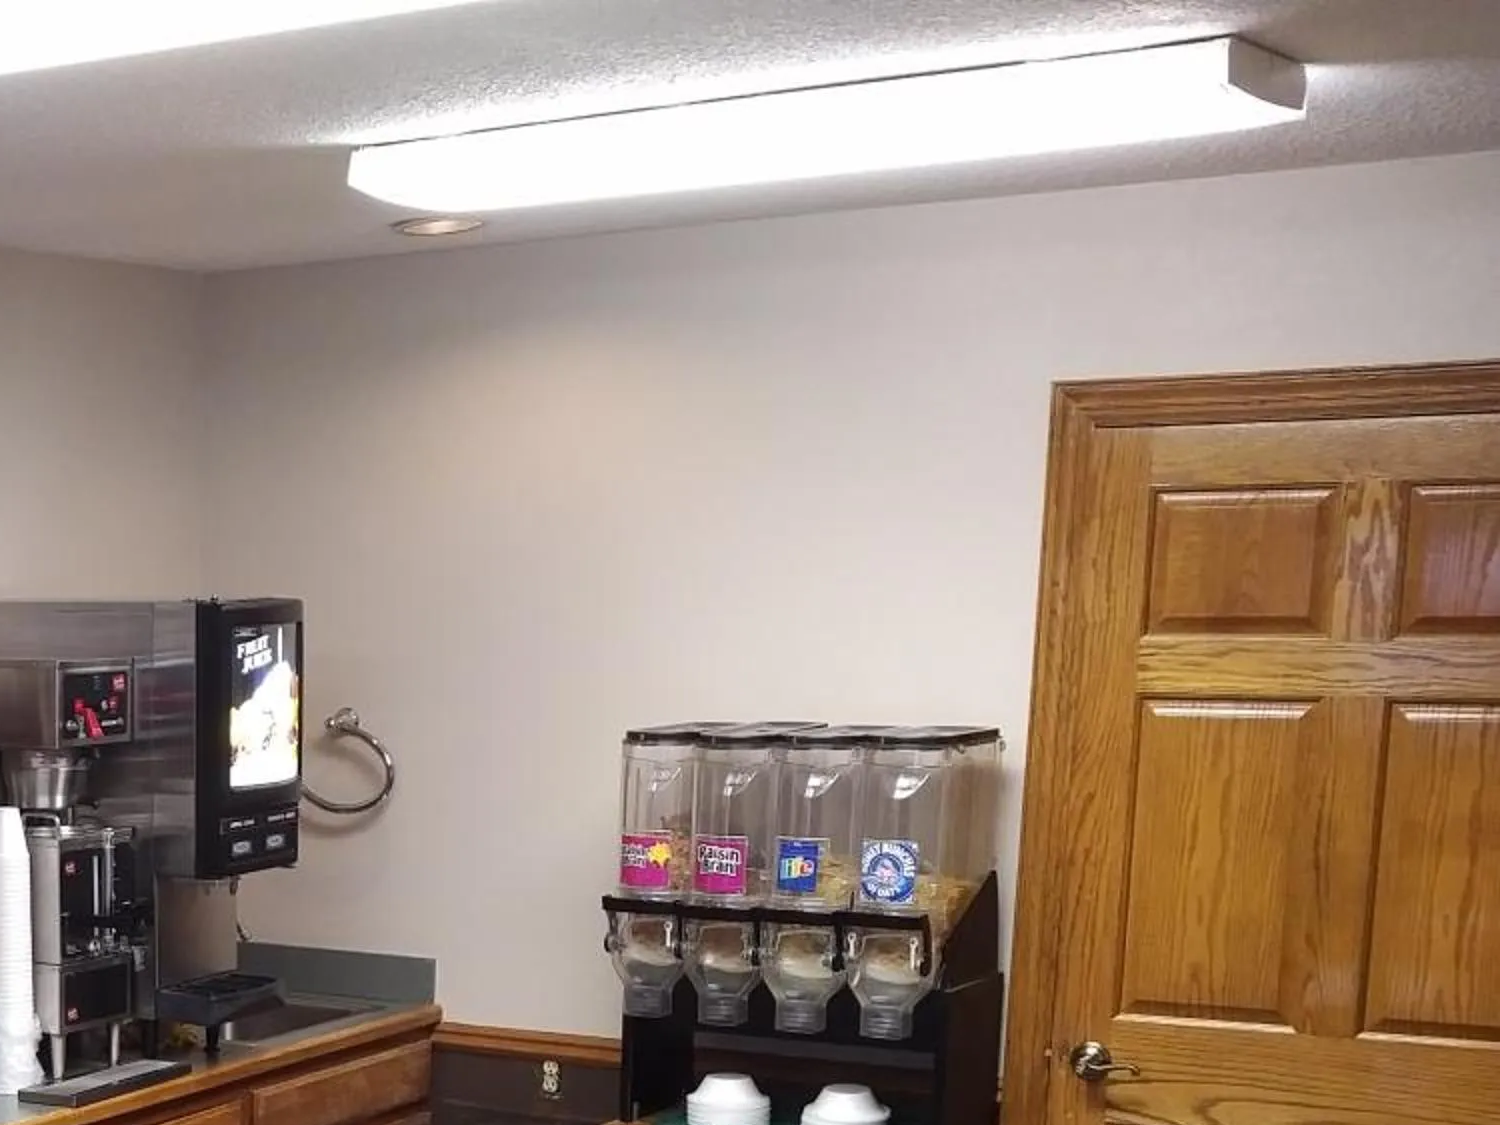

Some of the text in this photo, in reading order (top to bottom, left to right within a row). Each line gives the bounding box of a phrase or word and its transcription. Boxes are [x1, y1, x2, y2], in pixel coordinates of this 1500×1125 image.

[236, 634, 269, 659] FRUIT
[699, 844, 740, 863] Raisin
[701, 858, 737, 876] Bran
